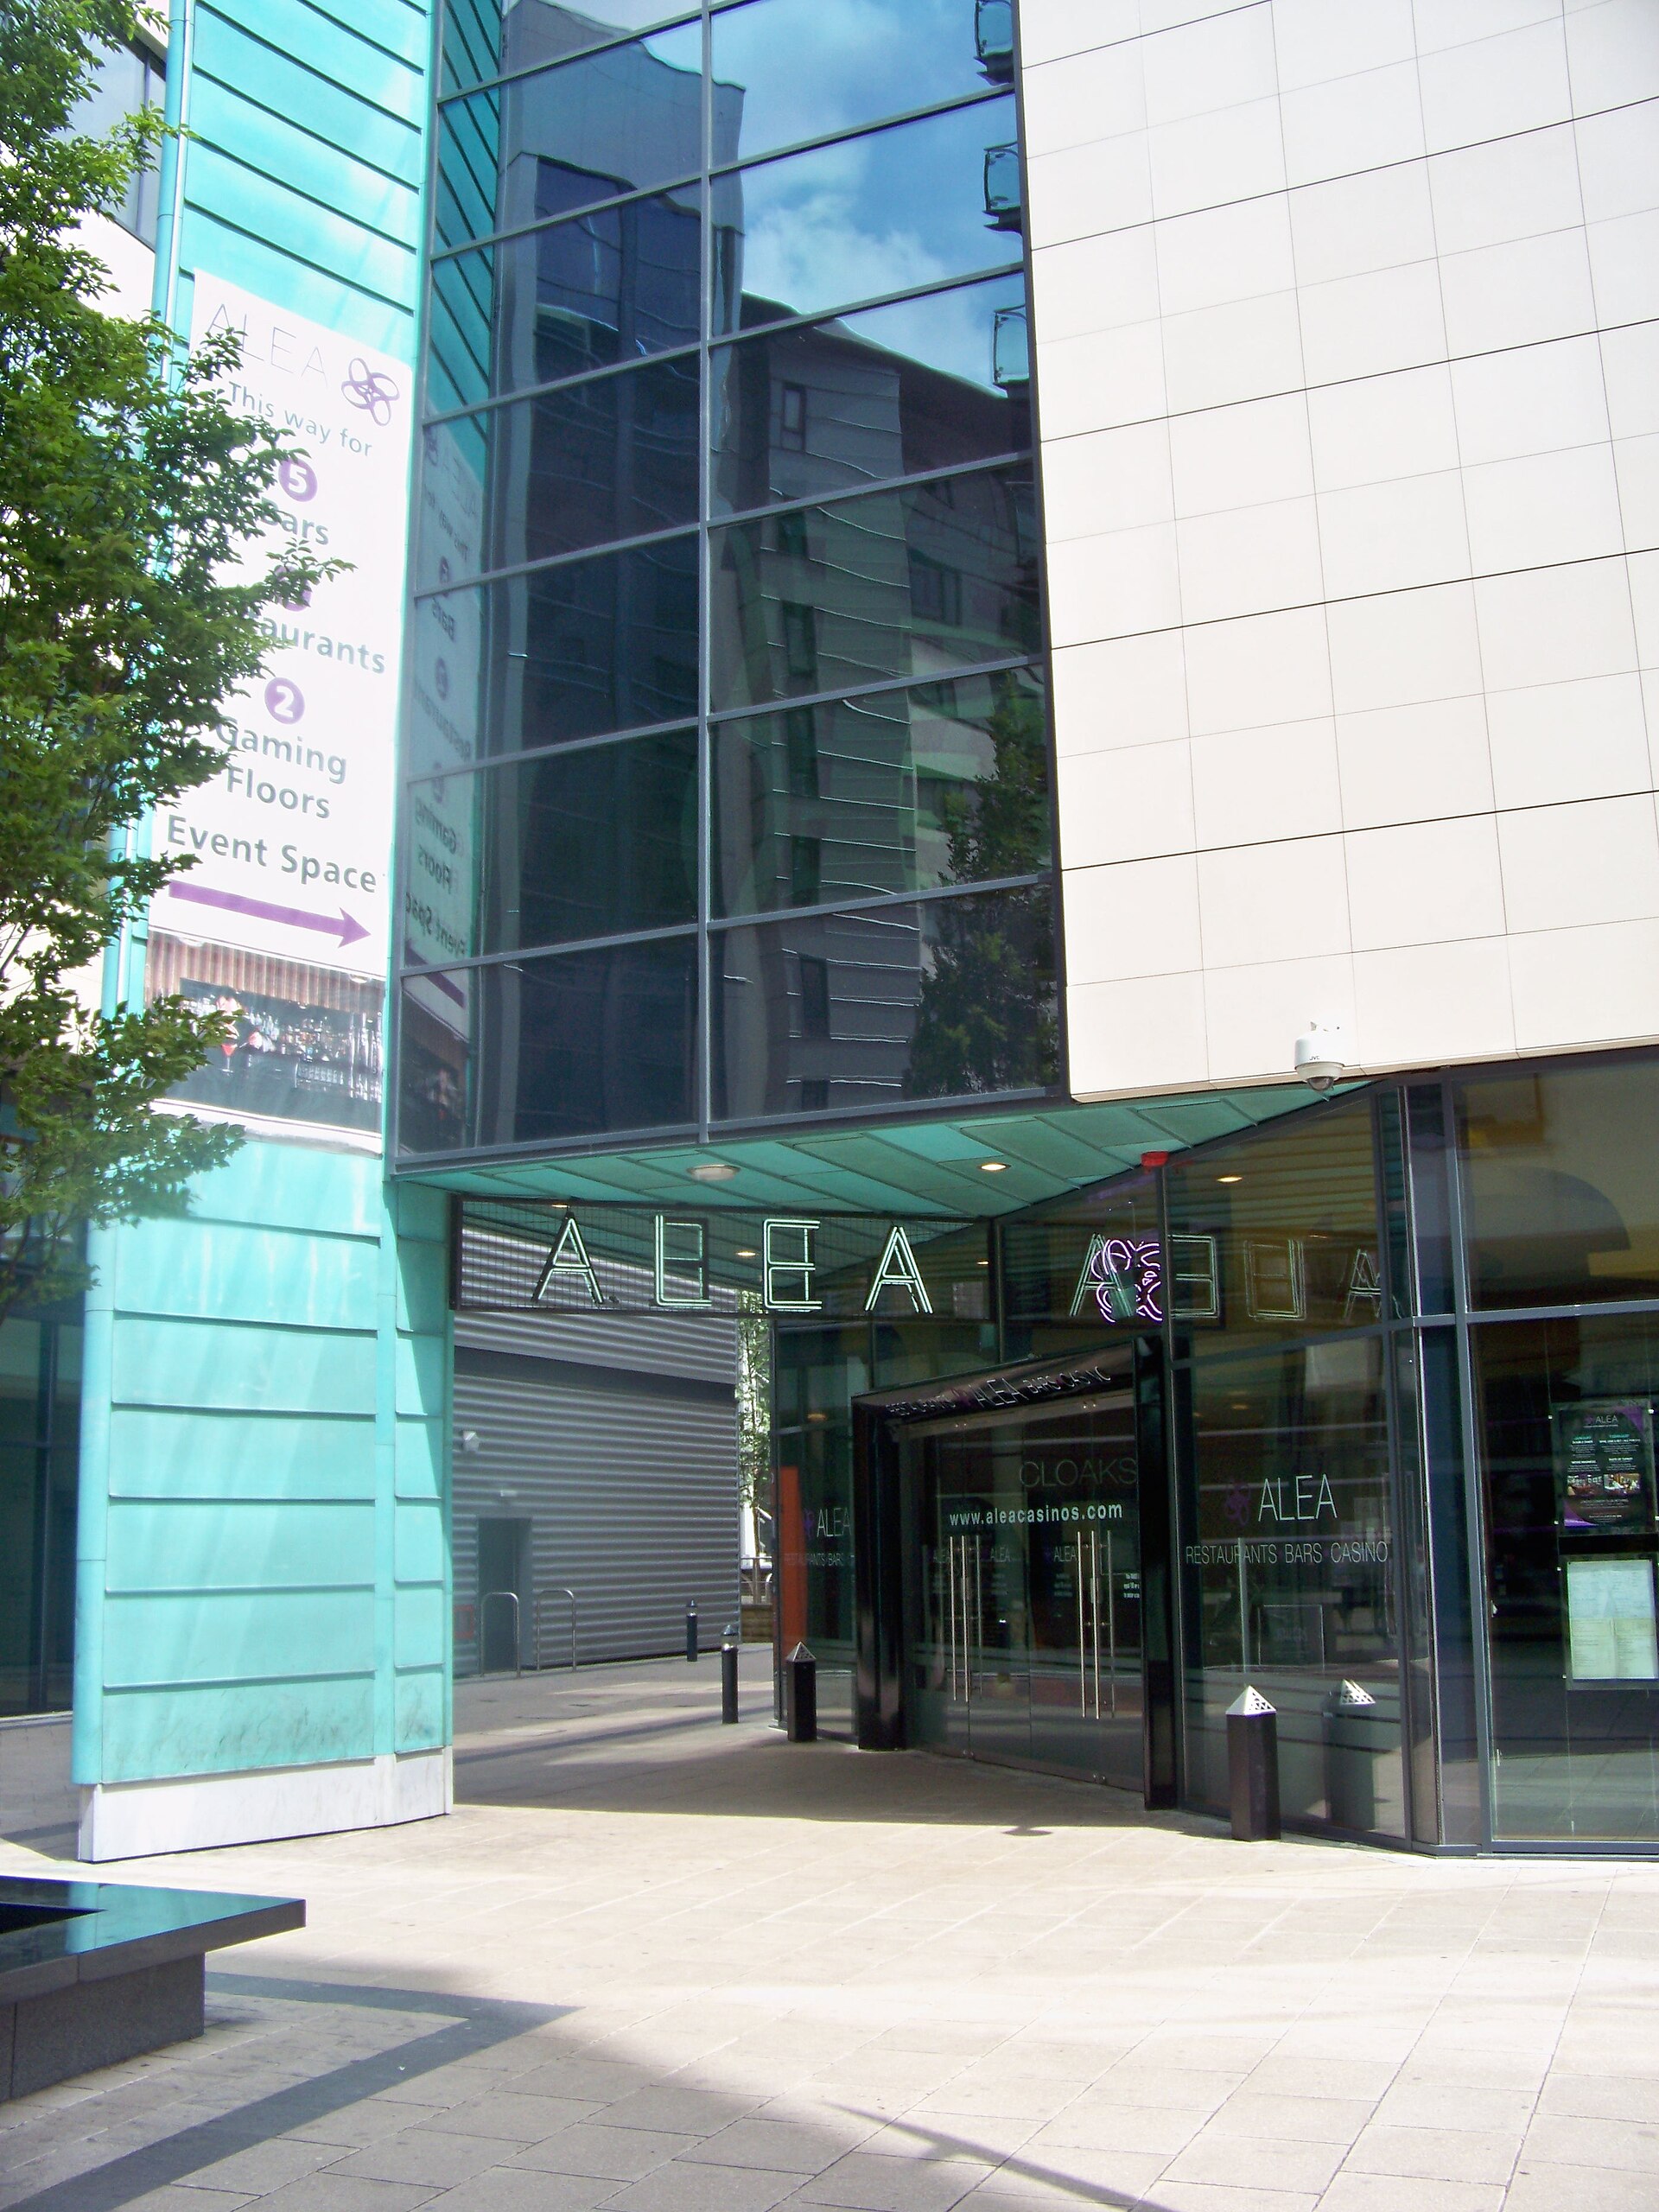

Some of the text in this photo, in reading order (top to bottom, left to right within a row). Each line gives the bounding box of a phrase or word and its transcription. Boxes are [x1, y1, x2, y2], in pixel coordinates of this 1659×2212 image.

[206, 304, 328, 389] ALEA
[229, 381, 372, 456] This way for
[249, 610, 385, 674] aurants
[216, 715, 346, 785] Gaming
[227, 766, 330, 819] Floors
[168, 814, 377, 893] Event Space
[531, 1211, 934, 1313] ALEA
[1596, 1414, 1618, 1424] ALEA
[817, 1507, 852, 1538] ALEA
[950, 1503, 1122, 1526] www.aleacasinos.com
[1258, 1474, 1337, 1522] ALEA
[1054, 1545, 1077, 1563] ALEA
[1185, 1541, 1389, 1565] RESTAURANTS BARS CASINO
